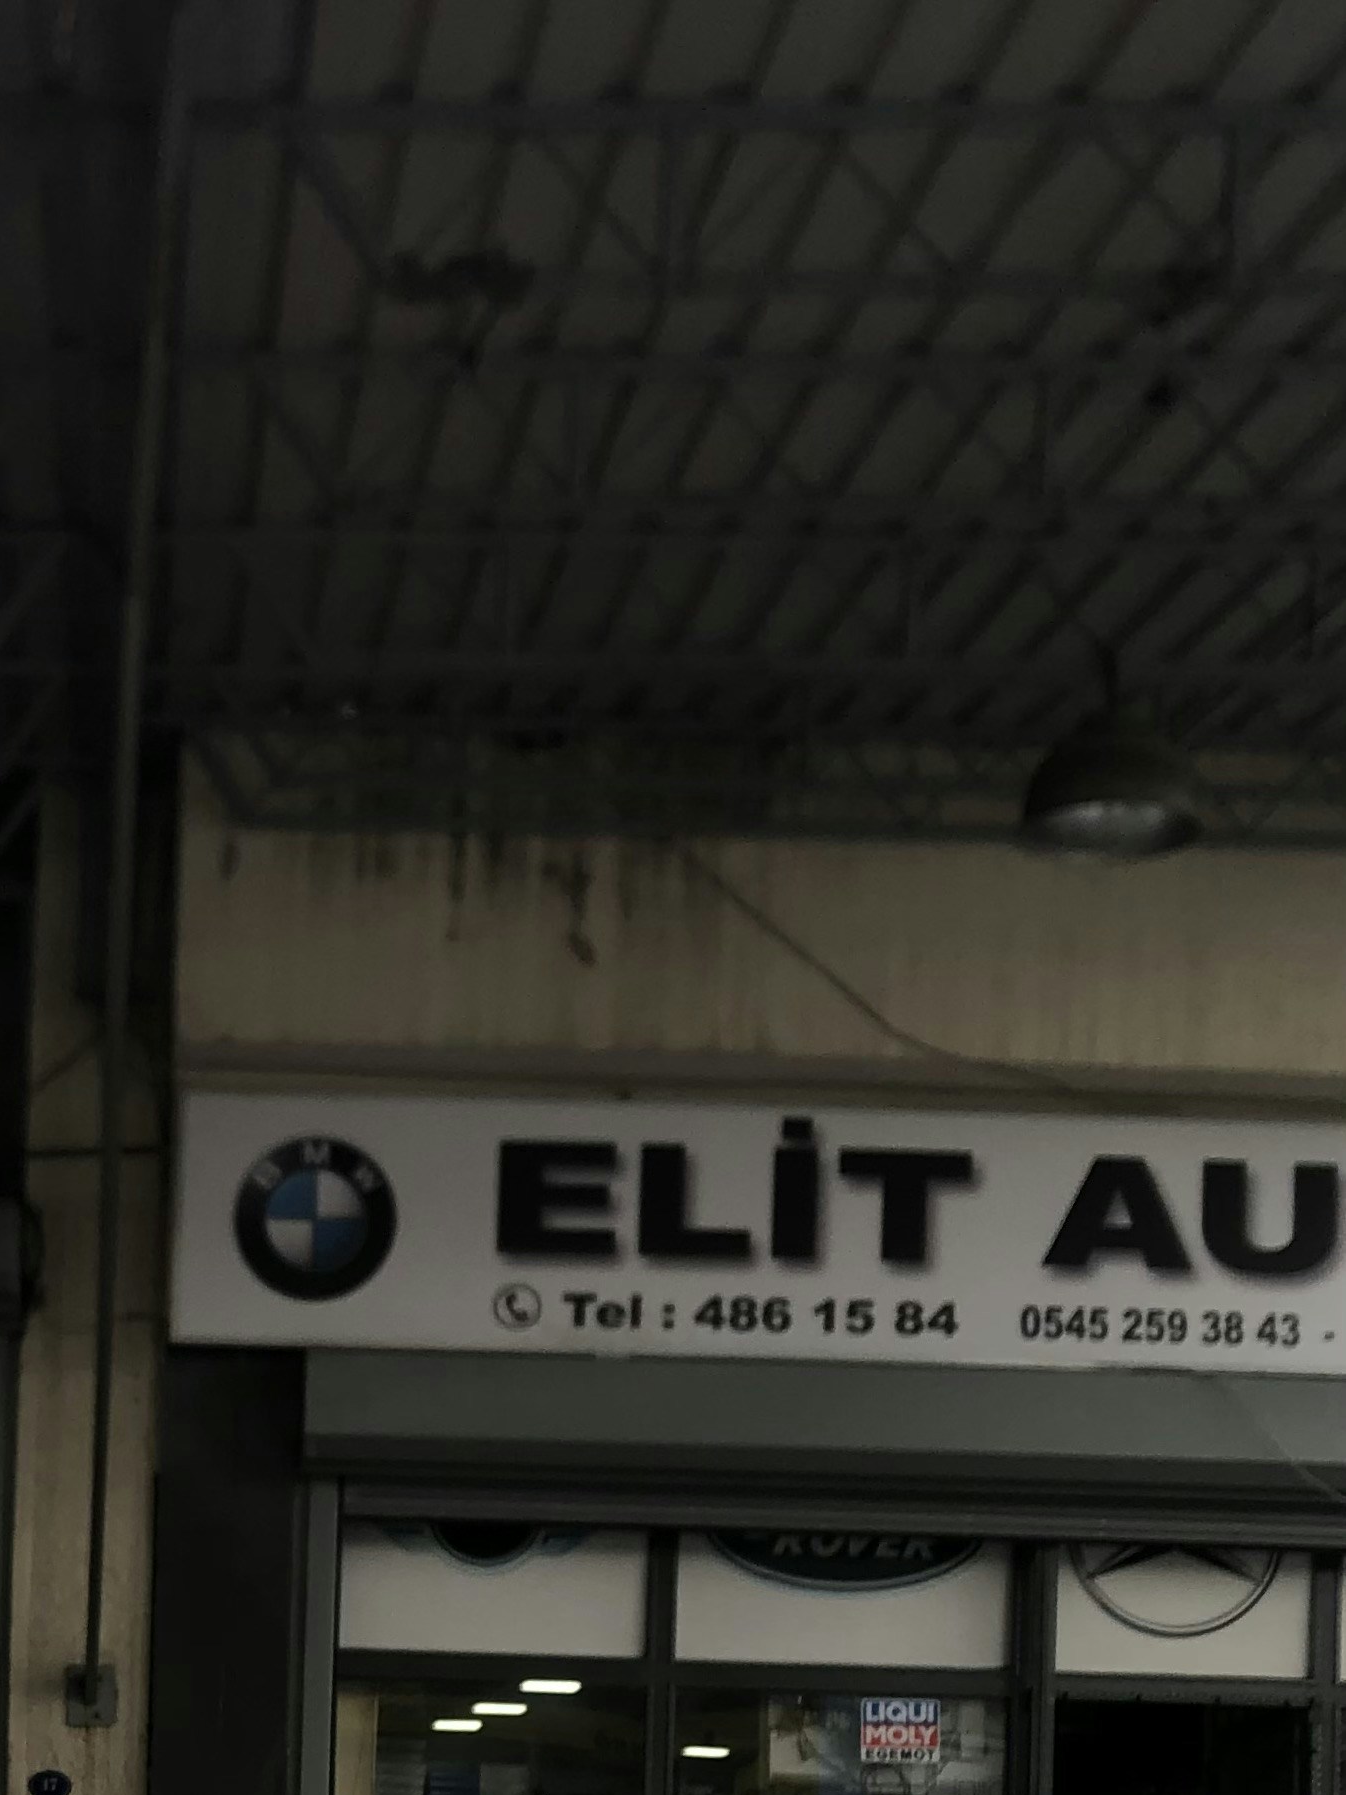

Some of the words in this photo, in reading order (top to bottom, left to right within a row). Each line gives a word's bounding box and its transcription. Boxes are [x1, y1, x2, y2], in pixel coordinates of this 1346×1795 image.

[497, 1117, 975, 1266] ELİT
[565, 1293, 642, 1328] Tel
[694, 1296, 792, 1333] 486
[814, 1300, 874, 1334] 15
[895, 1301, 958, 1337] 84
[1020, 1304, 1108, 1340] 0545
[1122, 1307, 1187, 1342] 259
[1203, 1310, 1244, 1345] 38
[1257, 1312, 1300, 1347] 43
[865, 1701, 935, 1723] LIQUI
[865, 1724, 938, 1746] MOLY
